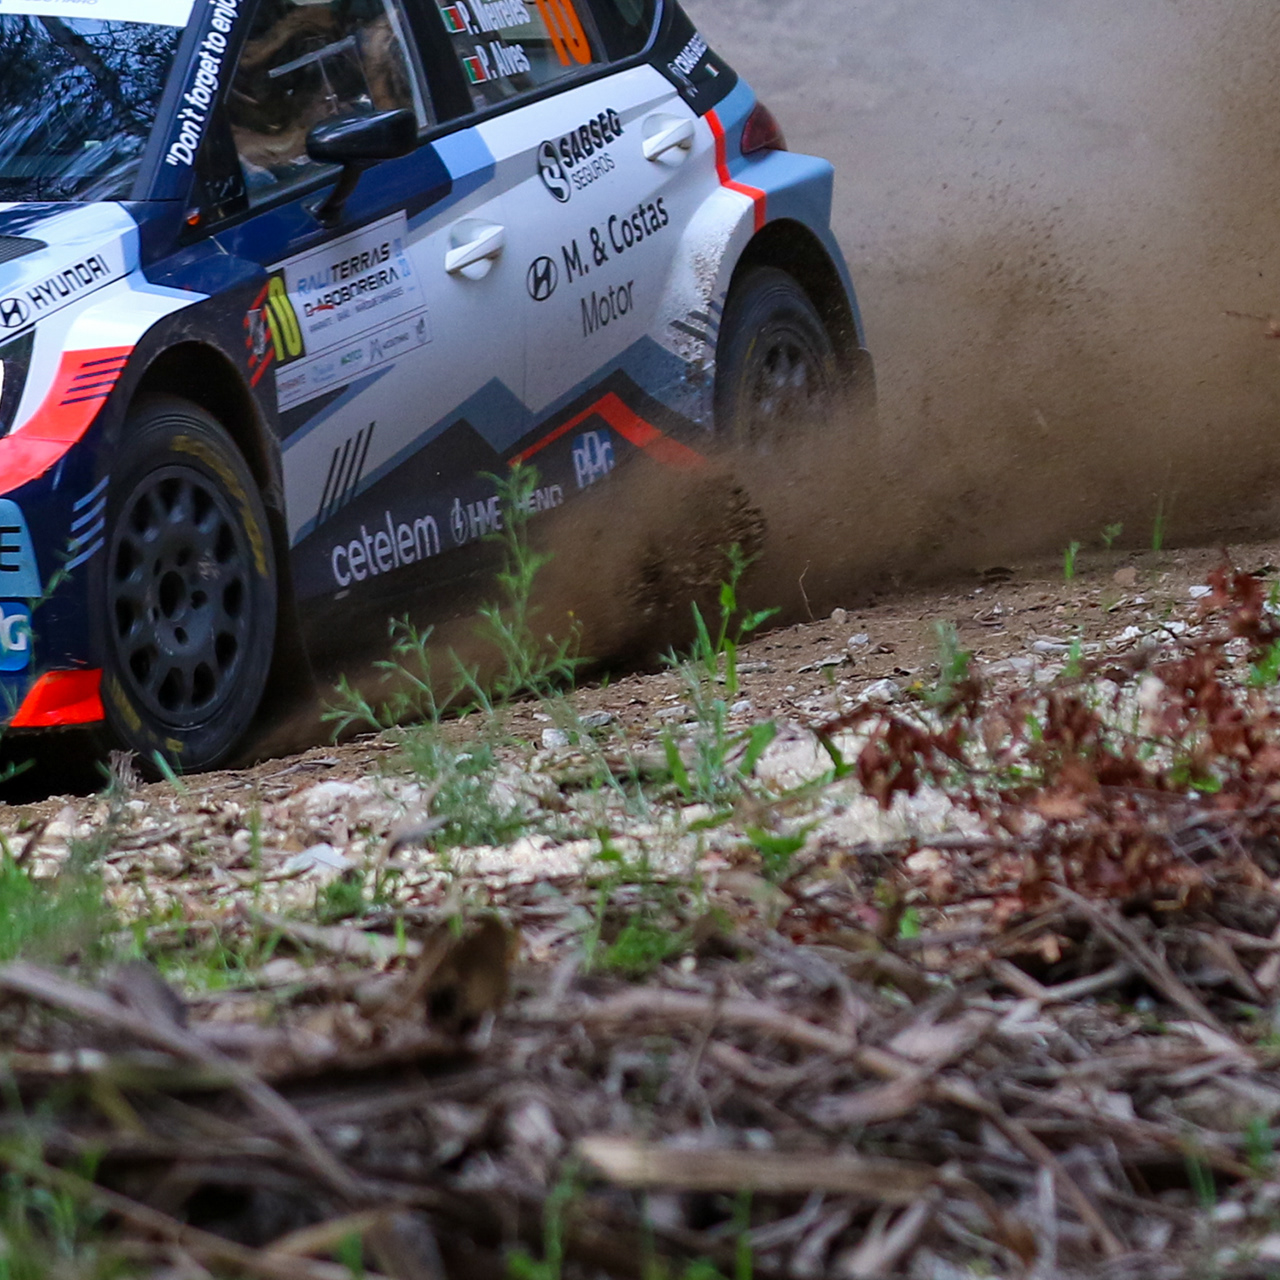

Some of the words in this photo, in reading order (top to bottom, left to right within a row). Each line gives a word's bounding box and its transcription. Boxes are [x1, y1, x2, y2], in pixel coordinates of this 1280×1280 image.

[201, 31, 227, 54] to
[455, 0, 480, 36] P.
[184, 51, 222, 111] forget
[474, 44, 498, 81] P.
[488, 40, 532, 78] Alves
[558, 107, 625, 169] SABSEG
[570, 152, 617, 191] SEGUROS
[561, 238, 590, 284] M.
[589, 226, 610, 267] &
[607, 196, 670, 255] Costas
[25, 253, 112, 311] HYUNDAI
[580, 279, 635, 338] Motor
[265, 276, 302, 362] 10
[572, 430, 616, 488] PPG
[330, 510, 441, 587] cetelem
